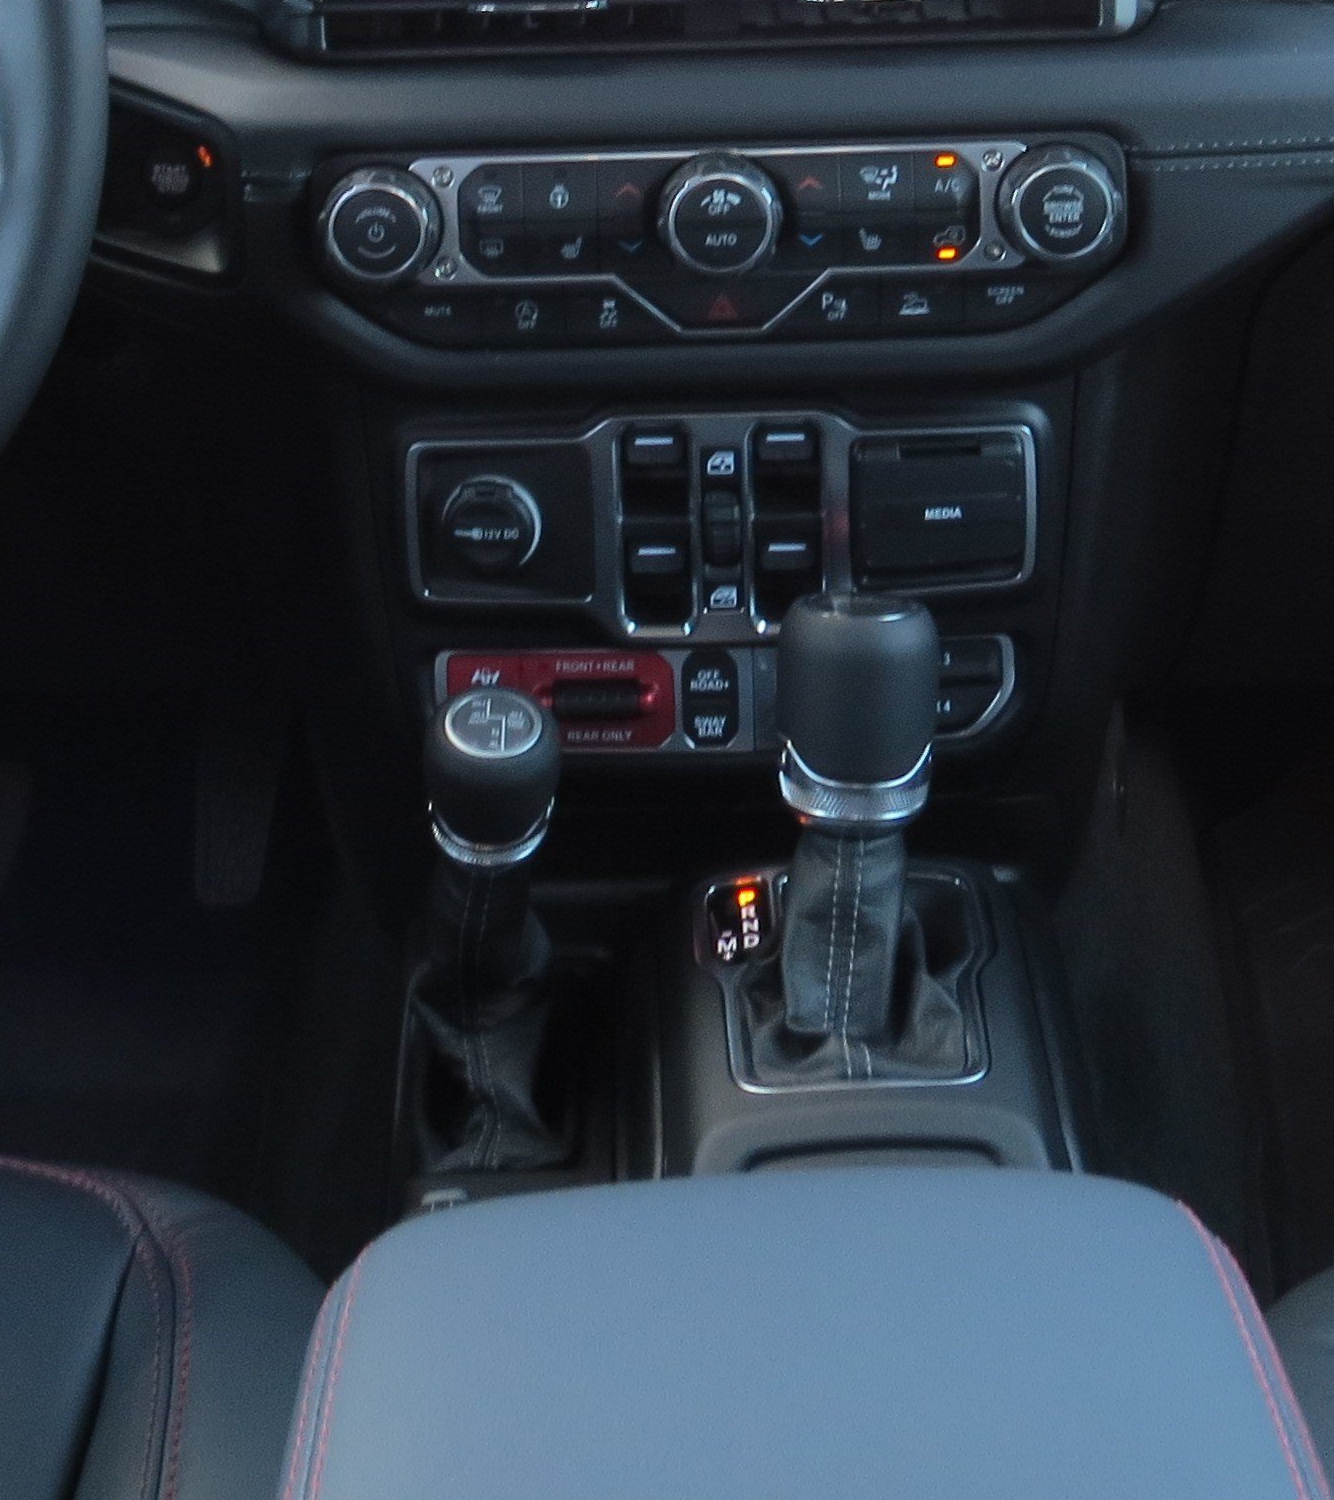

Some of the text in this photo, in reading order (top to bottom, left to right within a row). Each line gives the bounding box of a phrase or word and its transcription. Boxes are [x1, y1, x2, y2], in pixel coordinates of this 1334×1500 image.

[933, 176, 963, 194] A/C
[707, 204, 731, 218] OFF
[705, 233, 738, 248] AUTO
[424, 305, 453, 317] MUTE
[924, 506, 963, 521] MEDIA
[697, 668, 720, 681] OFF
[693, 715, 727, 729] SWAY
[567, 729, 633, 742] REAR ONLY
[698, 725, 724, 738] BAR
[717, 935, 738, 954] M
[743, 933, 761, 949] D
